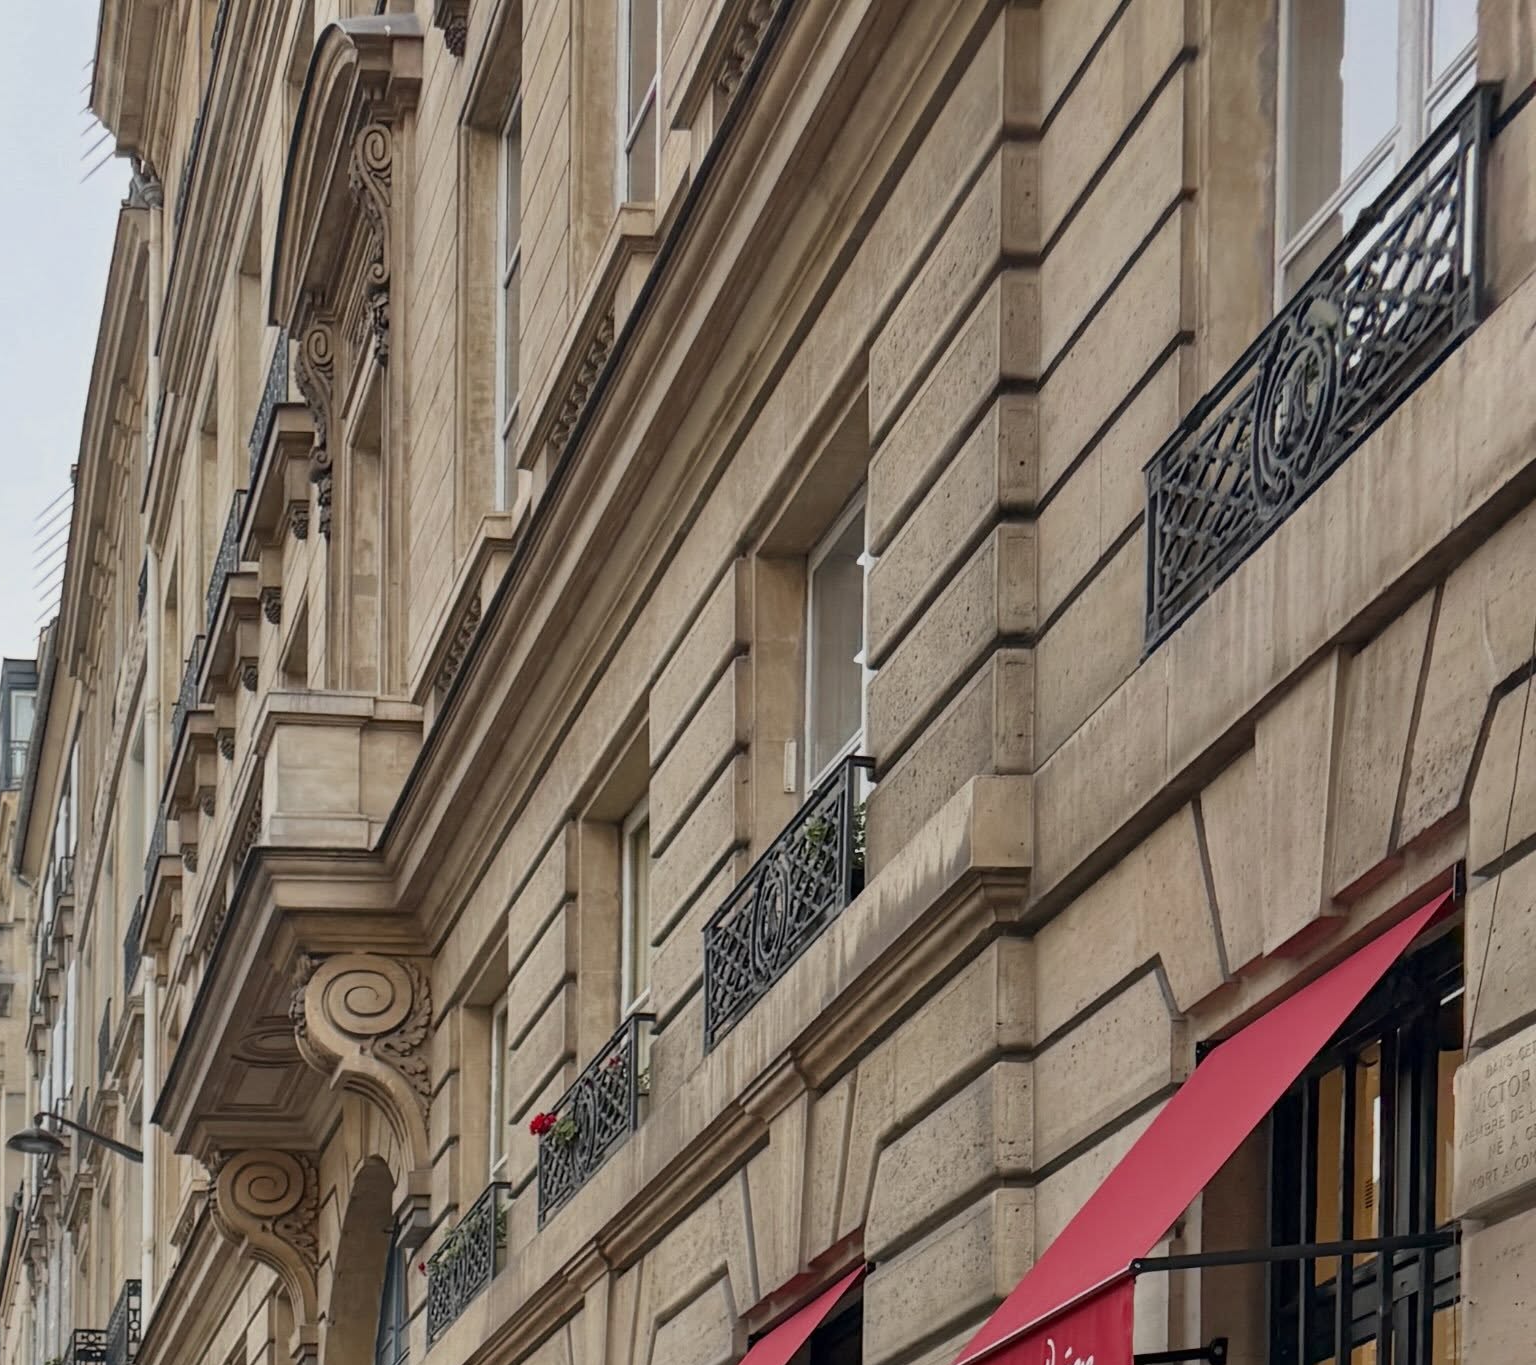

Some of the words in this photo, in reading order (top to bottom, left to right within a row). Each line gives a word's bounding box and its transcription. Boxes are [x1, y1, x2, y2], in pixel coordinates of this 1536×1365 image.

[1472, 1068, 1531, 1113] VICTOR
[1459, 1115, 1505, 1150] MEMBRE
[1510, 1104, 1524, 1124] DE
[1468, 1167, 1498, 1192] MORT
